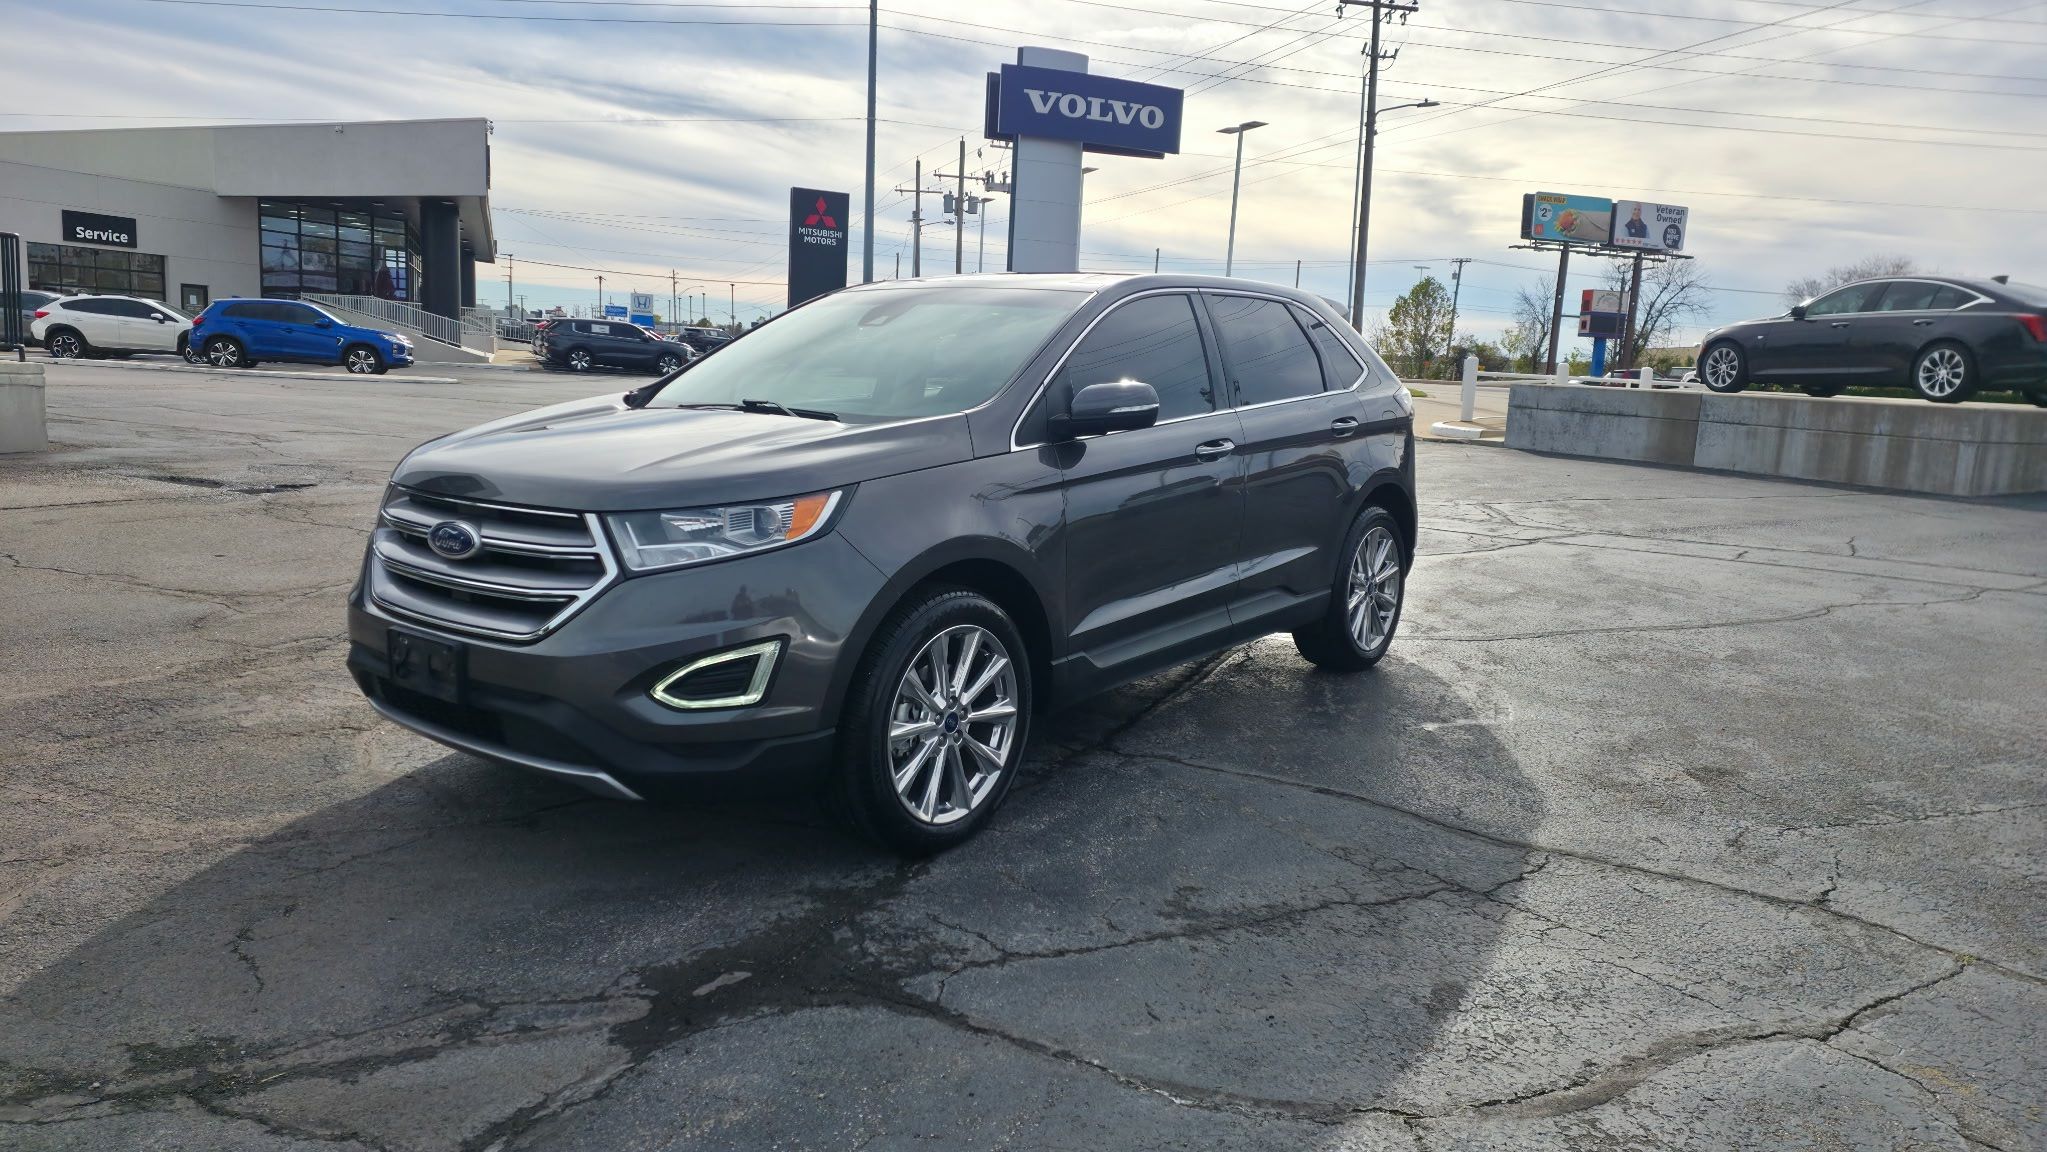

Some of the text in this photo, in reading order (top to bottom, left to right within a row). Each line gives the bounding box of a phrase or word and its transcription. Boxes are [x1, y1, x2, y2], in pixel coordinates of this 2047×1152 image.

[1024, 88, 1164, 129] VOLVO
[1656, 204, 1685, 216] Veteran
[1656, 214, 1682, 224] Owned
[75, 226, 128, 243] Service
[798, 227, 842, 239] MITSUBISHI
[804, 236, 837, 246] MOTORS
